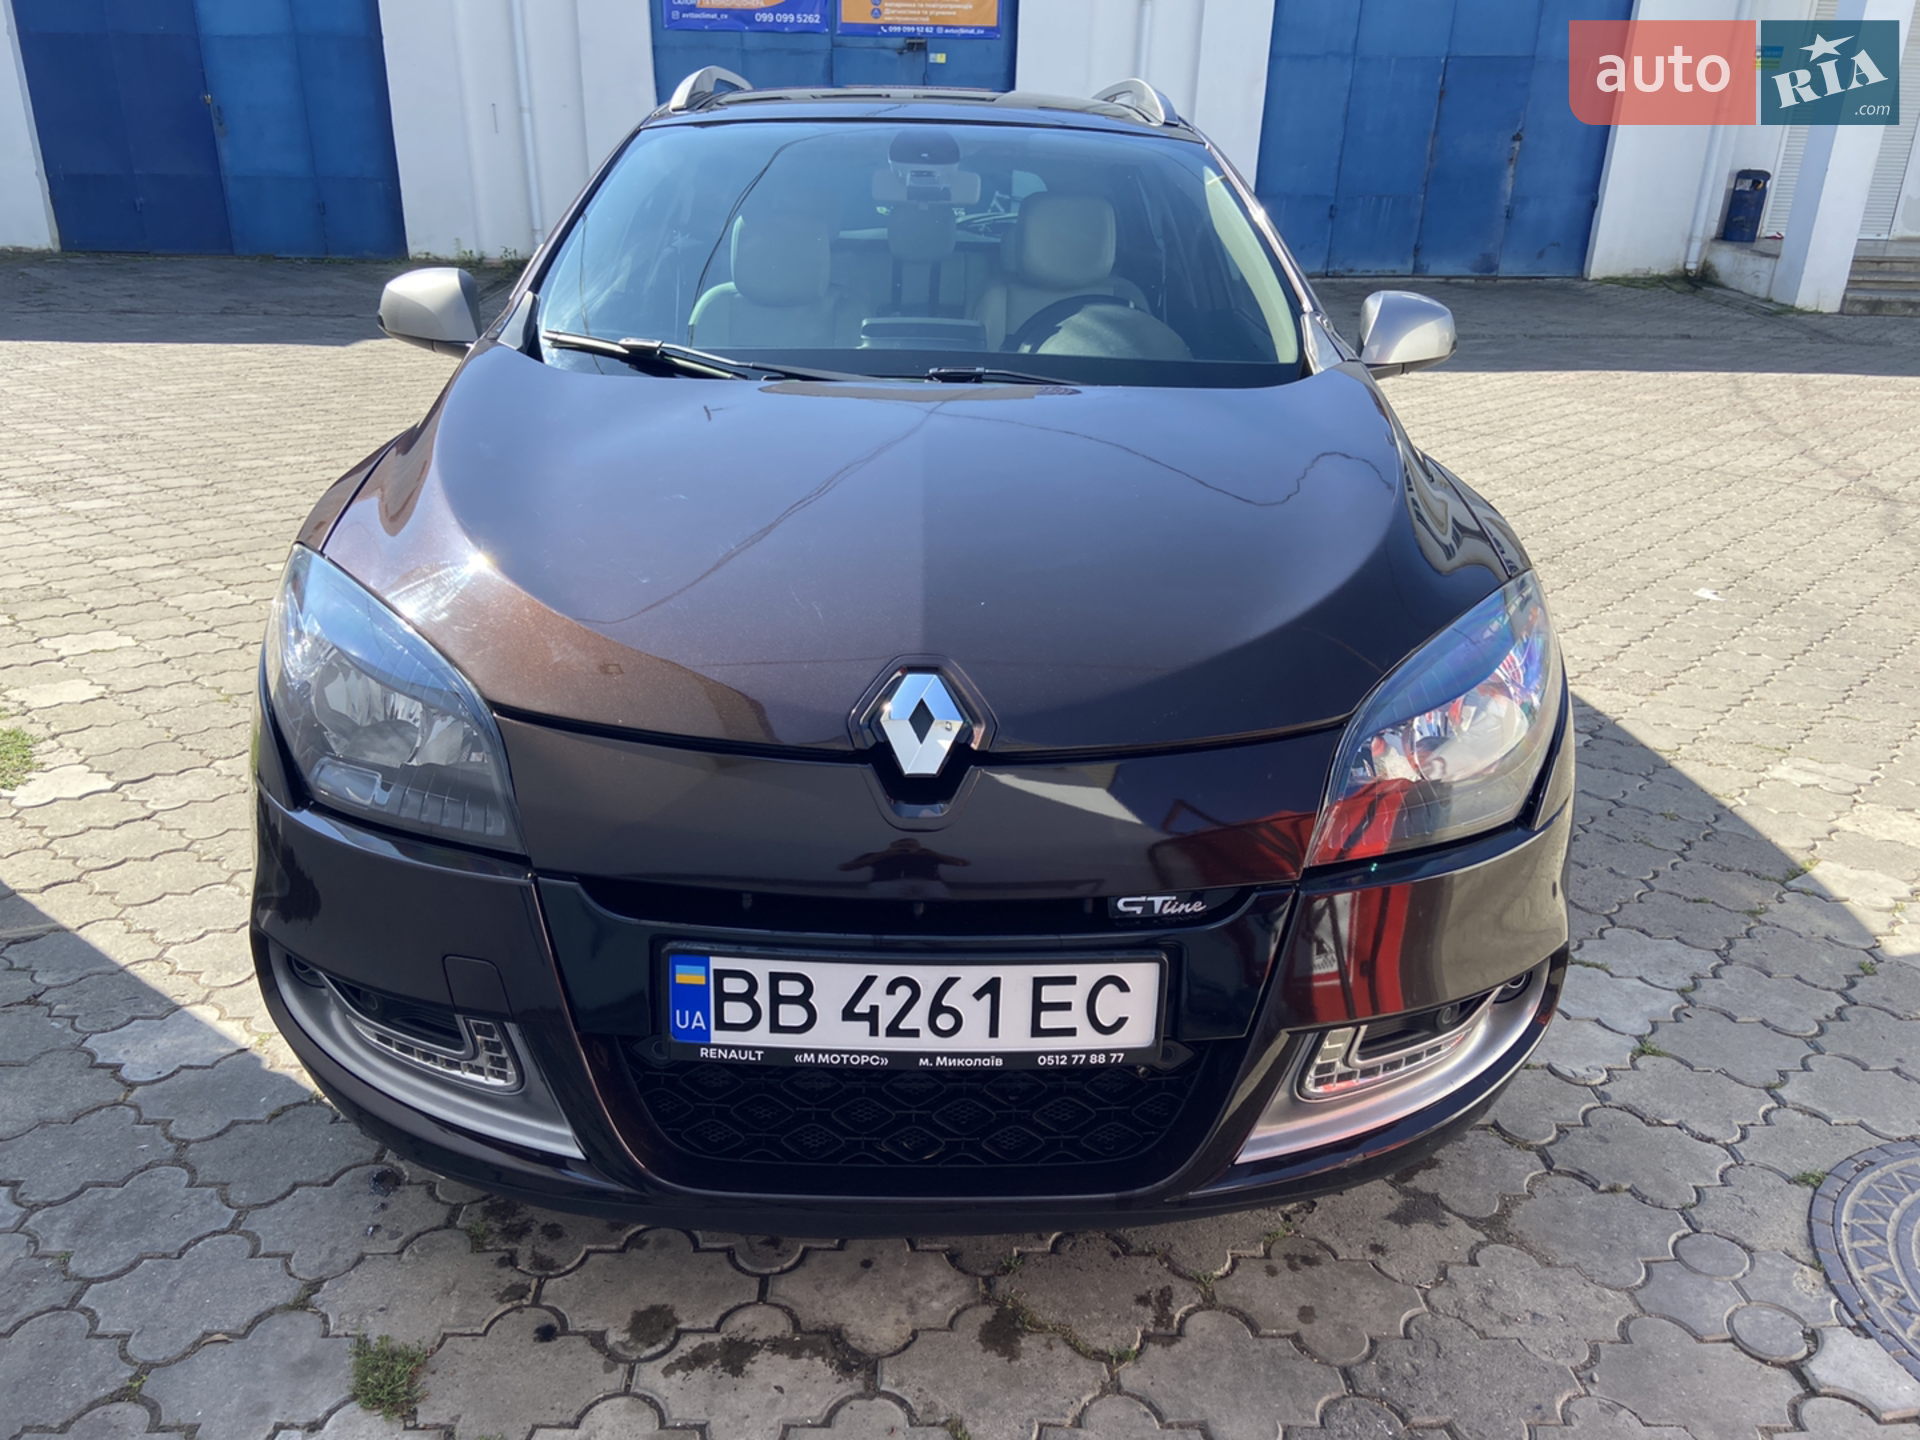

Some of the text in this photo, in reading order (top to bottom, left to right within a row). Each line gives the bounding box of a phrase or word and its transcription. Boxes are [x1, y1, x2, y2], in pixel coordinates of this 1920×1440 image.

[755, 13, 820, 24] 099 099 5262
[713, 968, 1131, 1038] BB 4261 EC
[676, 1010, 706, 1030] UA
[700, 1048, 764, 1062] RENAULT
[818, 1053, 888, 1067] МОТОРС»
[919, 1057, 933, 1067] м.
[935, 1056, 1003, 1067] Миколаїв
[1038, 1055, 1068, 1066] 0512
[1071, 1054, 1086, 1065] 77
[1089, 1053, 1106, 1064] 88
[1110, 1052, 1125, 1064] 77
